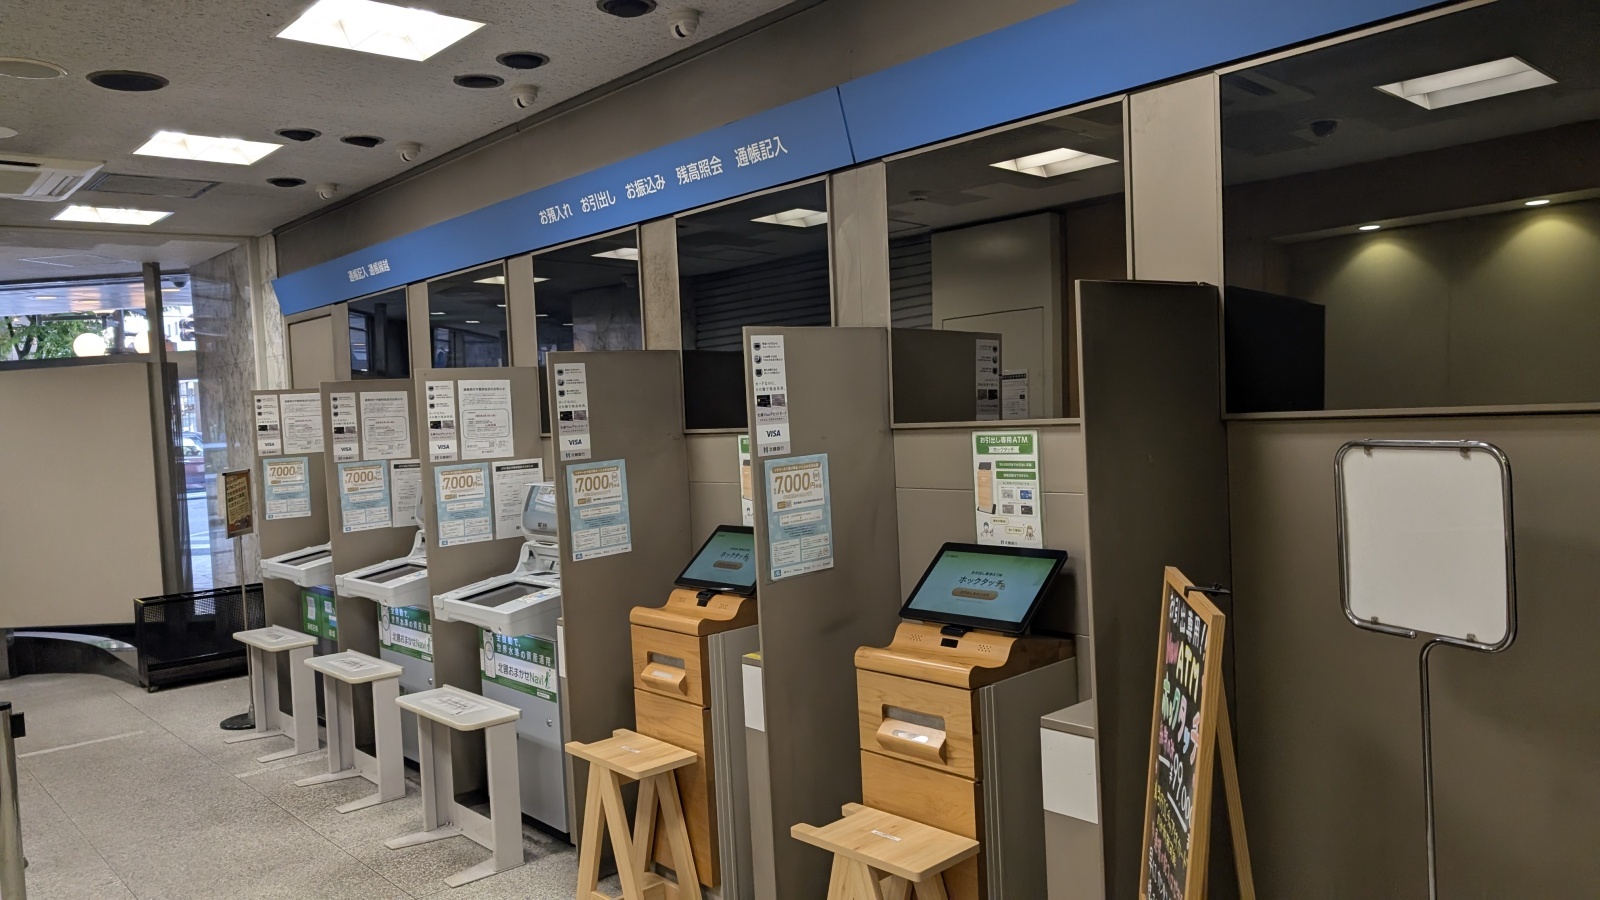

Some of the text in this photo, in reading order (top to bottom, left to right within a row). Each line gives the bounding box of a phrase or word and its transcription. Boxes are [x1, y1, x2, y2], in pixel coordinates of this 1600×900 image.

[538, 136, 788, 225] お預入れ お引出し お振込み 残高照会 通帳記入
[766, 430, 781, 438] VISA
[980, 436, 1028, 444] お引出し専用ATM
[959, 576, 1004, 588] ホックタッチ
[497, 662, 544, 686] 北國おまかせNavi
[1176, 641, 1200, 704] ATM
[1162, 671, 1201, 766] ホックタッチ
